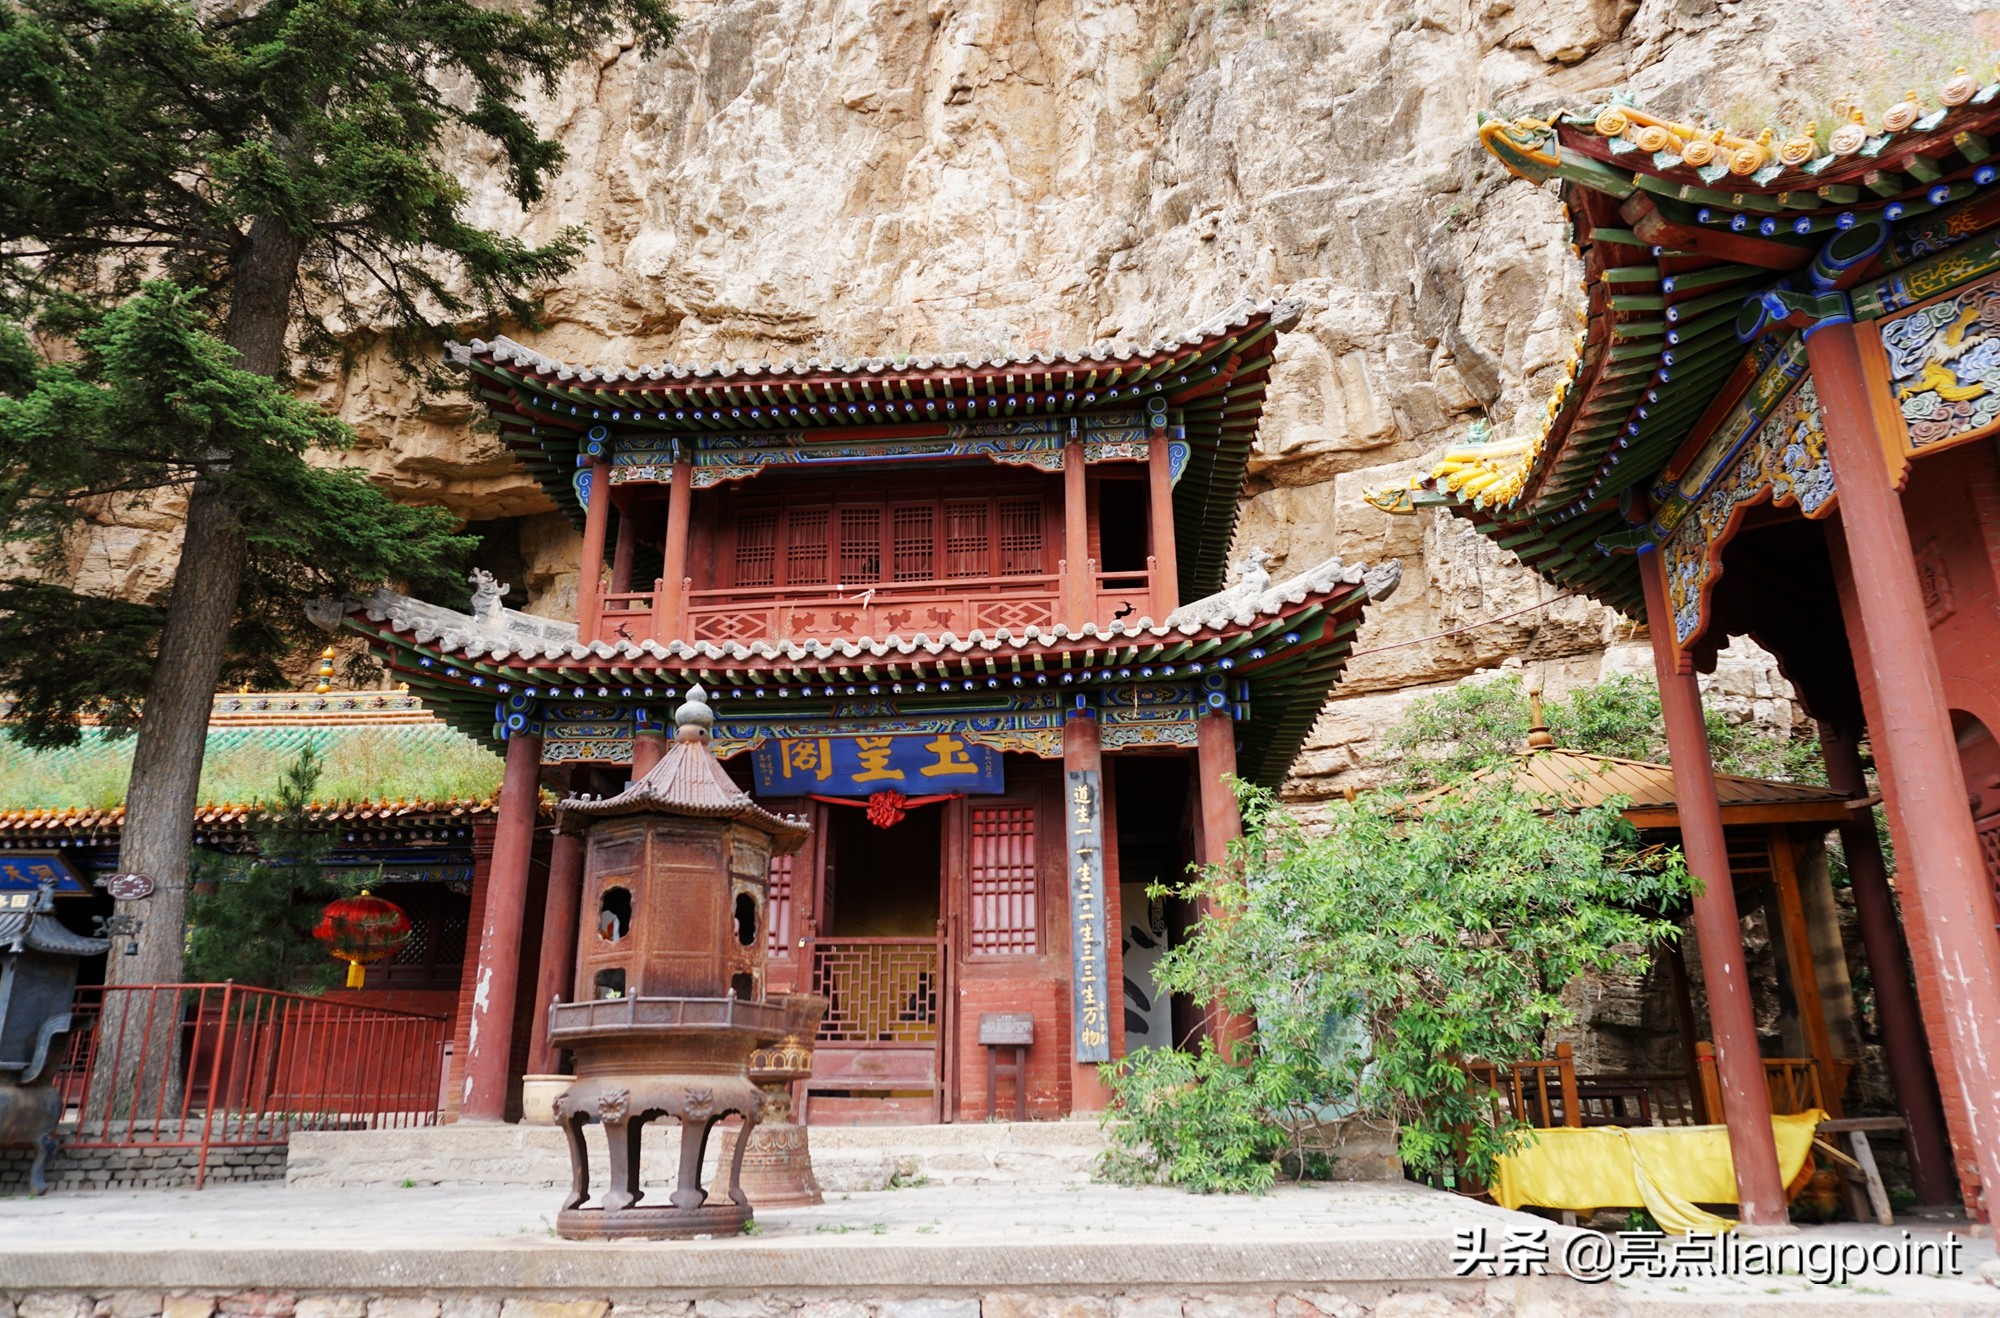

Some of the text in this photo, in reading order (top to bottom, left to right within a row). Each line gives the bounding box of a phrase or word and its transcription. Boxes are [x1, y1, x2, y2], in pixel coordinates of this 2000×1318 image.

[1074, 784, 1099, 1047] 道生一一生二二生三三生万物
